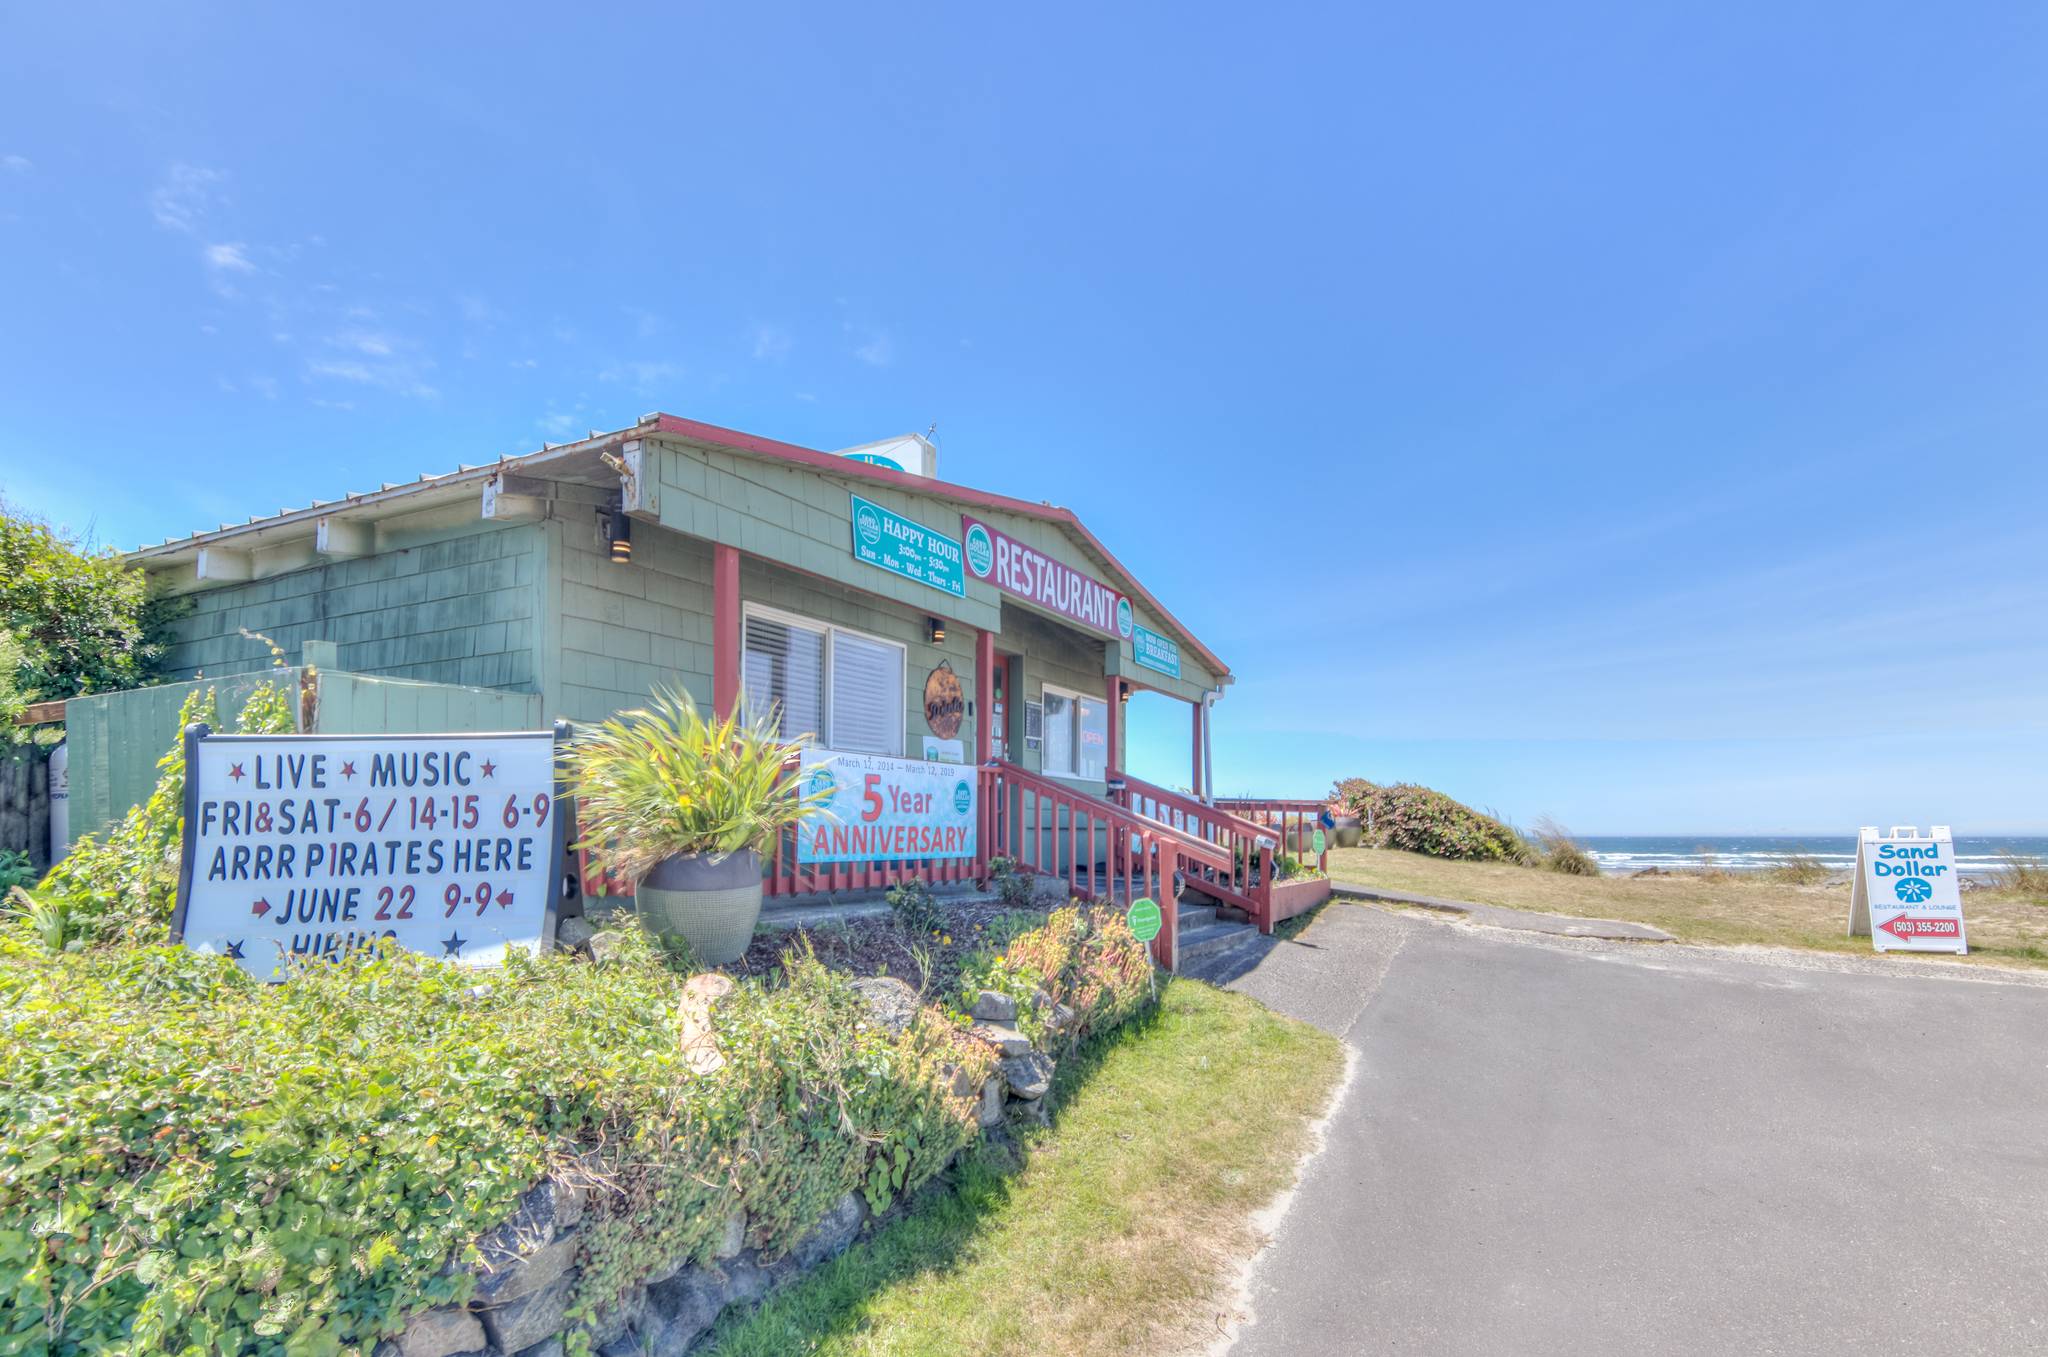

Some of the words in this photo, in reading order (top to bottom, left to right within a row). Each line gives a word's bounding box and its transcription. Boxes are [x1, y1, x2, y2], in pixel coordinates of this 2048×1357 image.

[883, 517, 924, 548] HAPPY
[927, 537, 960, 564] HOUR
[861, 545, 876, 560] Sun
[883, 554, 900, 569] Mon
[906, 562, 922, 577] Wed
[928, 571, 946, 587] Thurs
[952, 580, 961, 593] Fri
[996, 536, 1116, 630] RESTAURANT
[255, 753, 326, 789] LIVE
[370, 751, 471, 787] MUSIC
[838, 757, 860, 769] March
[905, 764, 925, 774] March
[940, 767, 955, 777] 2019
[503, 793, 550, 829] 6-9
[860, 773, 884, 822] 5
[887, 784, 933, 815] Year
[208, 844, 294, 880] ARRR
[453, 837, 533, 873] HERE
[812, 824, 968, 855] ANNIVERSARY
[1878, 842, 1939, 859] Sand
[1874, 861, 1948, 877] Dollar
[275, 887, 361, 924] JUNE
[374, 884, 415, 921] 22
[444, 882, 492, 918] 9-9
[1893, 921, 1915, 934] (503)
[1916, 922, 1955, 933] 355-2200
